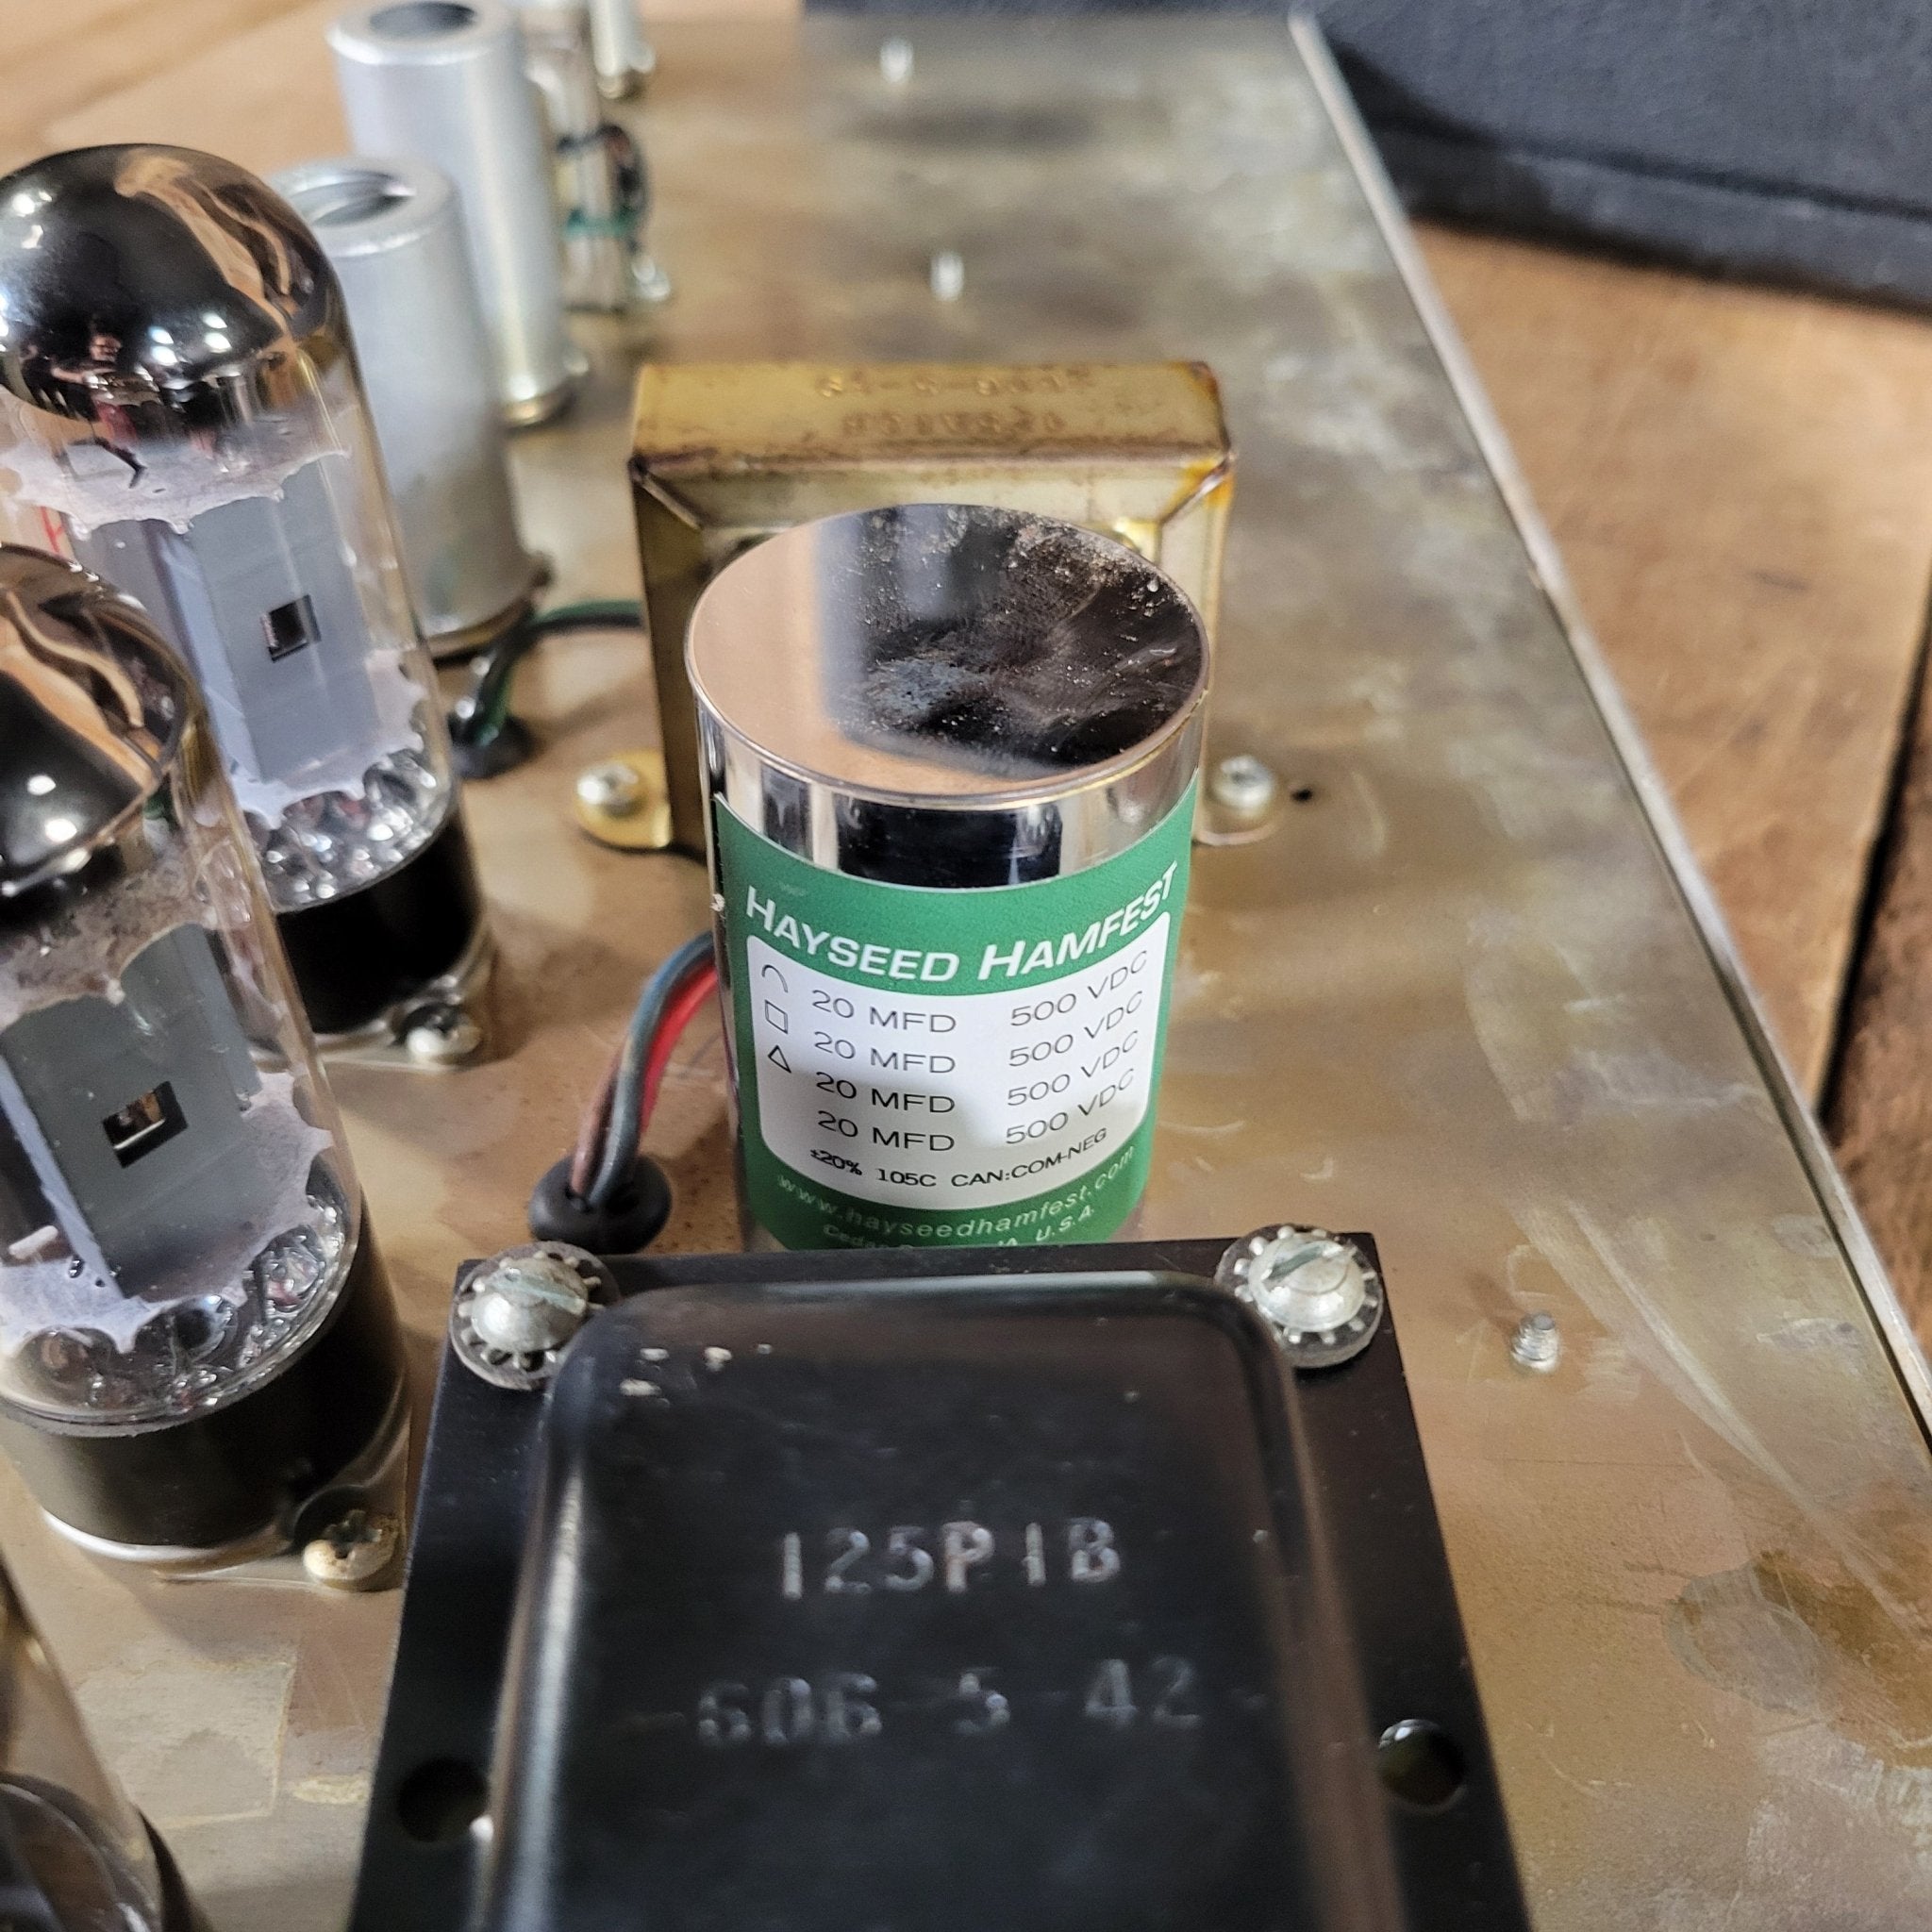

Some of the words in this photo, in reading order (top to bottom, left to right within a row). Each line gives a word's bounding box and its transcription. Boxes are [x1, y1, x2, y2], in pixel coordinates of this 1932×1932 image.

[746, 885, 960, 982] HAYSEED
[976, 859, 1177, 981] HAMFEST
[811, 990, 855, 1018] 20
[869, 1006, 957, 1033] MFD
[1010, 993, 1076, 1026] 500
[1087, 950, 1148, 999] VDC
[814, 1031, 857, 1059] 20
[870, 1047, 956, 1074] MFD
[1008, 1034, 1074, 1067] 500
[1083, 991, 1143, 1040] VDC
[816, 1072, 858, 1099] 20
[871, 1088, 956, 1113] MFD
[1007, 1074, 1071, 1106] 500
[1080, 1030, 1139, 1078] VDC
[818, 1110, 858, 1138] 20
[873, 1127, 955, 1151] MFD
[1006, 1112, 1069, 1144] 500
[1076, 1068, 1135, 1117] VDC
[777, 1145, 1135, 1238] www.hayseedhamfest.com
[877, 1168, 938, 1188] 105C
[951, 1127, 1108, 1188] CAN:COM-NEG
